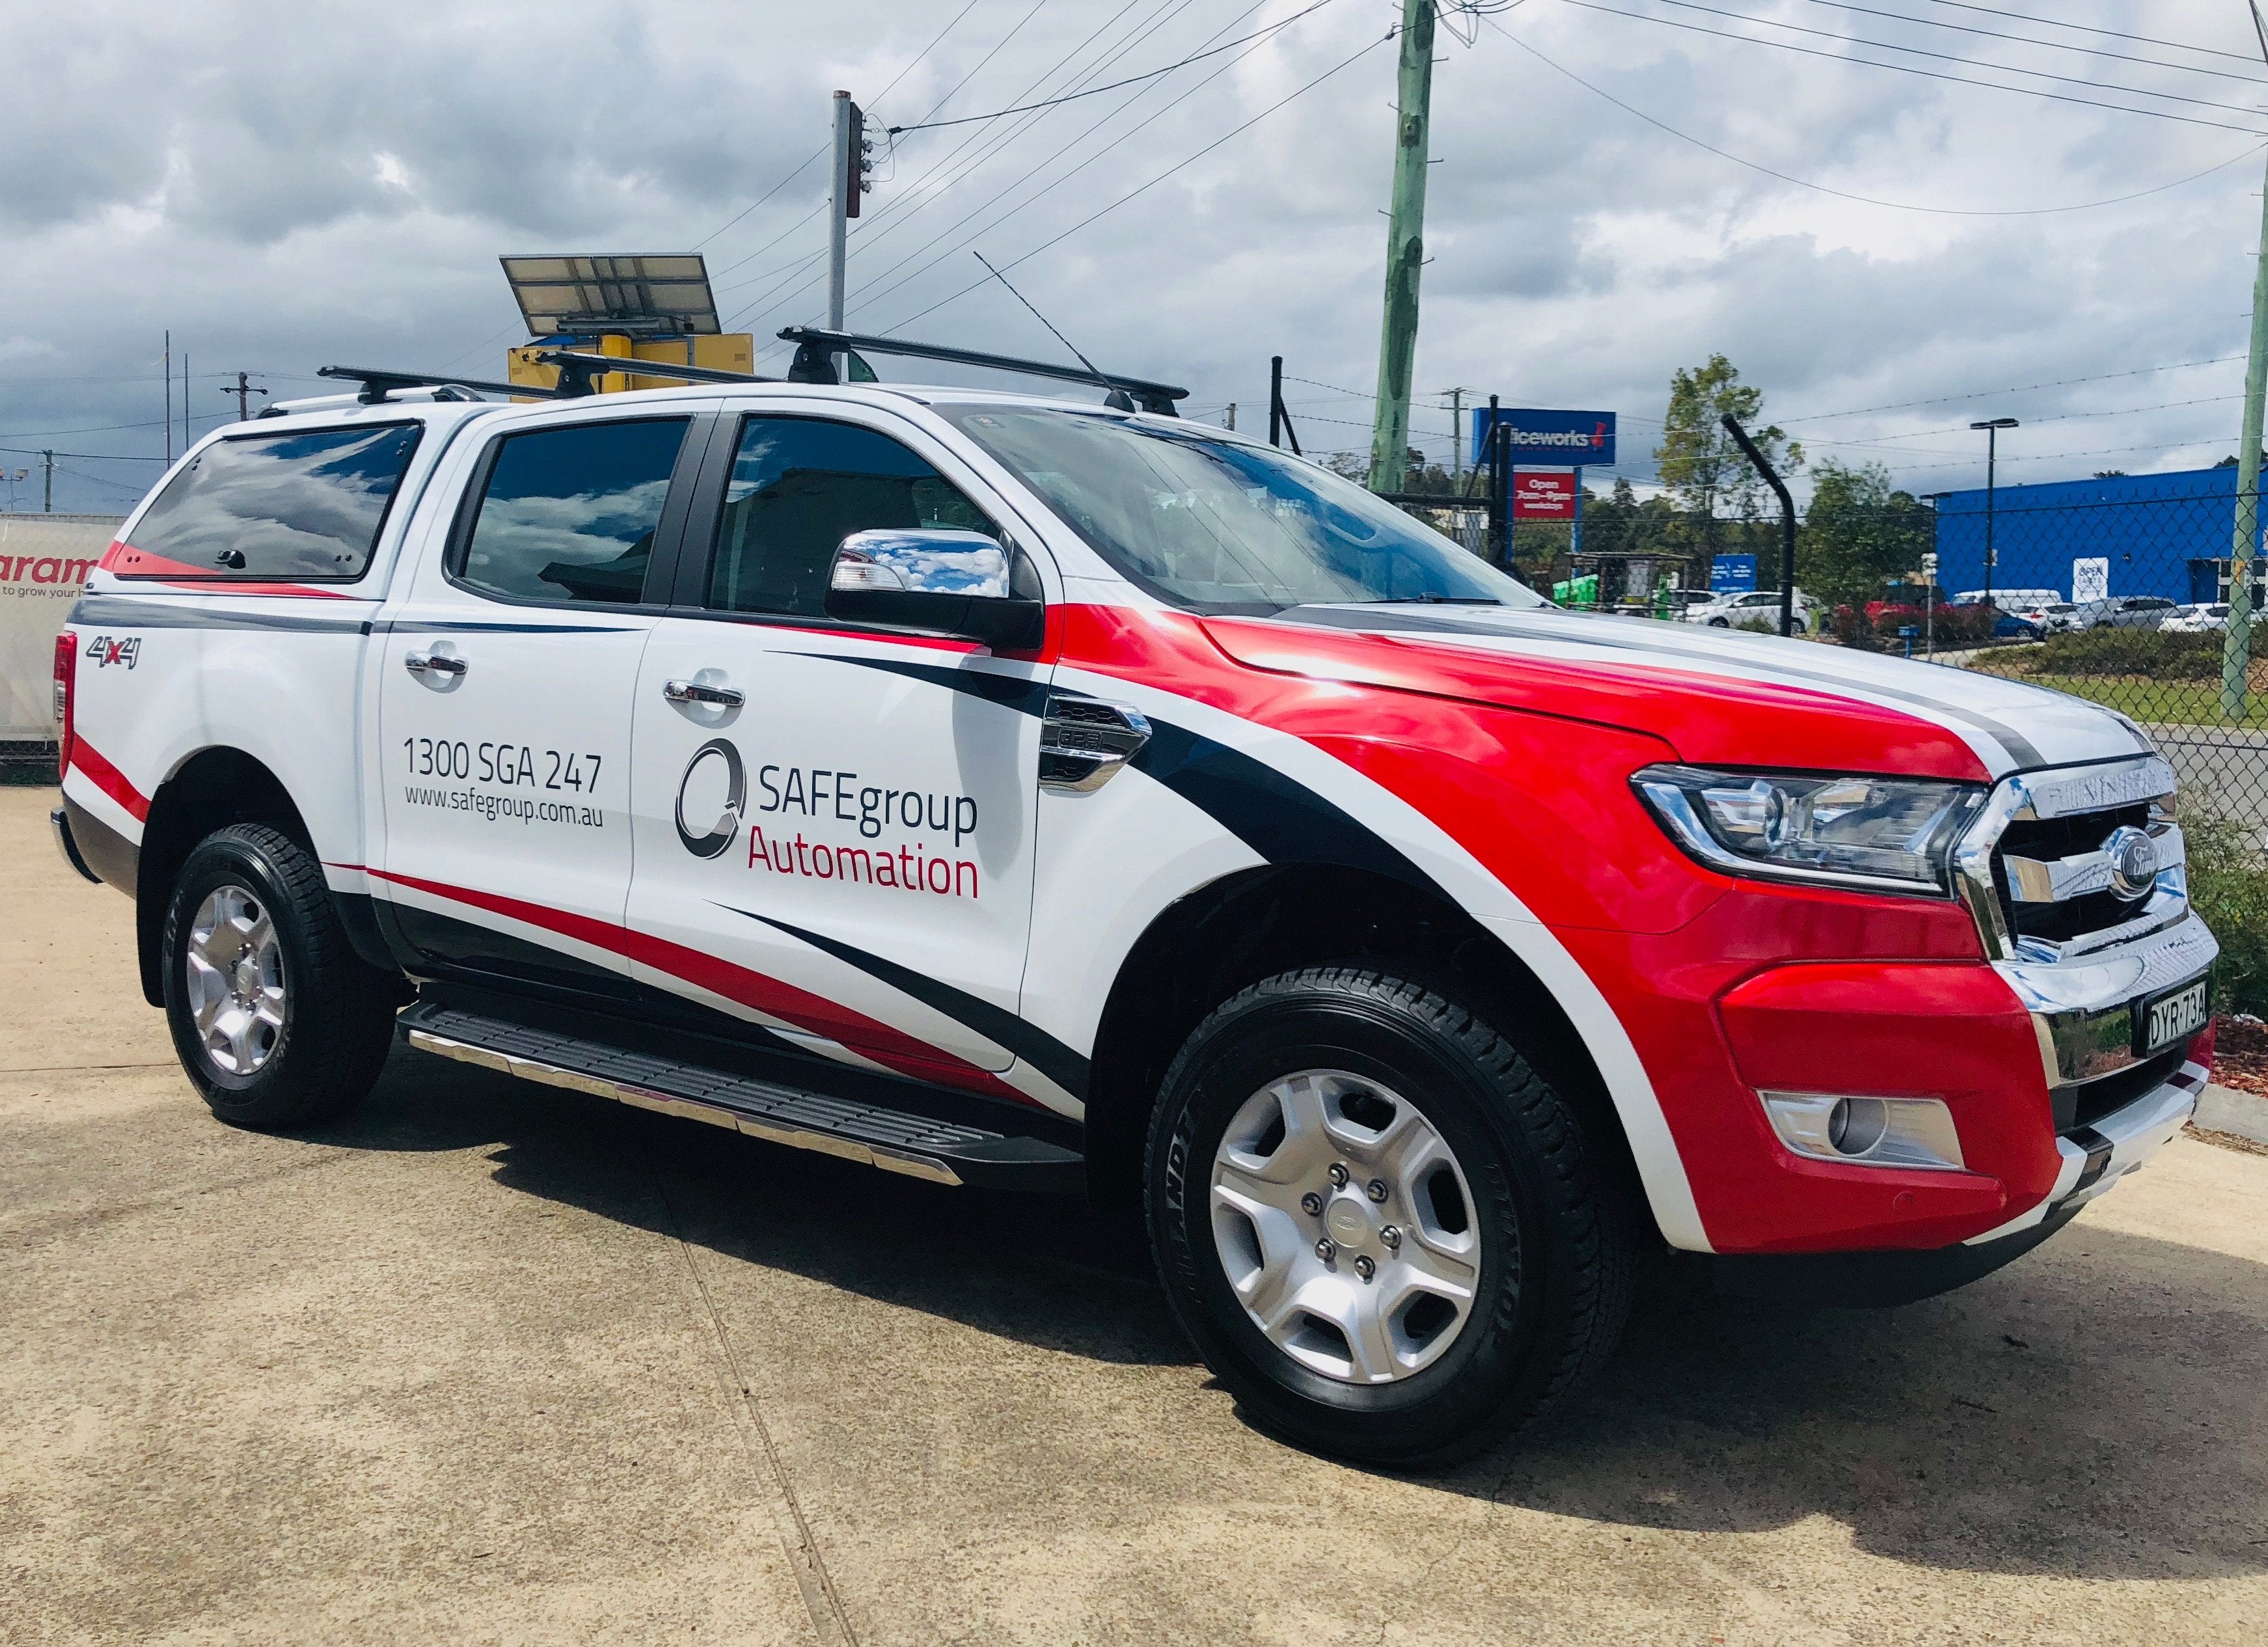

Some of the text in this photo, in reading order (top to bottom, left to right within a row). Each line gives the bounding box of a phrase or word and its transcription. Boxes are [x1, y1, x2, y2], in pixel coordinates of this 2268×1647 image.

[1497, 428, 1589, 446] ficeworks
[1529, 479, 1559, 491] Open
[3, 586, 15, 595] to
[18, 588, 47, 598] grow
[49, 590, 77, 599] your
[403, 737, 602, 794] 1300 SGA 247
[404, 785, 604, 828] www.safegroup.com.au
[759, 764, 979, 848] SAFEgroup
[747, 824, 978, 899] Automation
